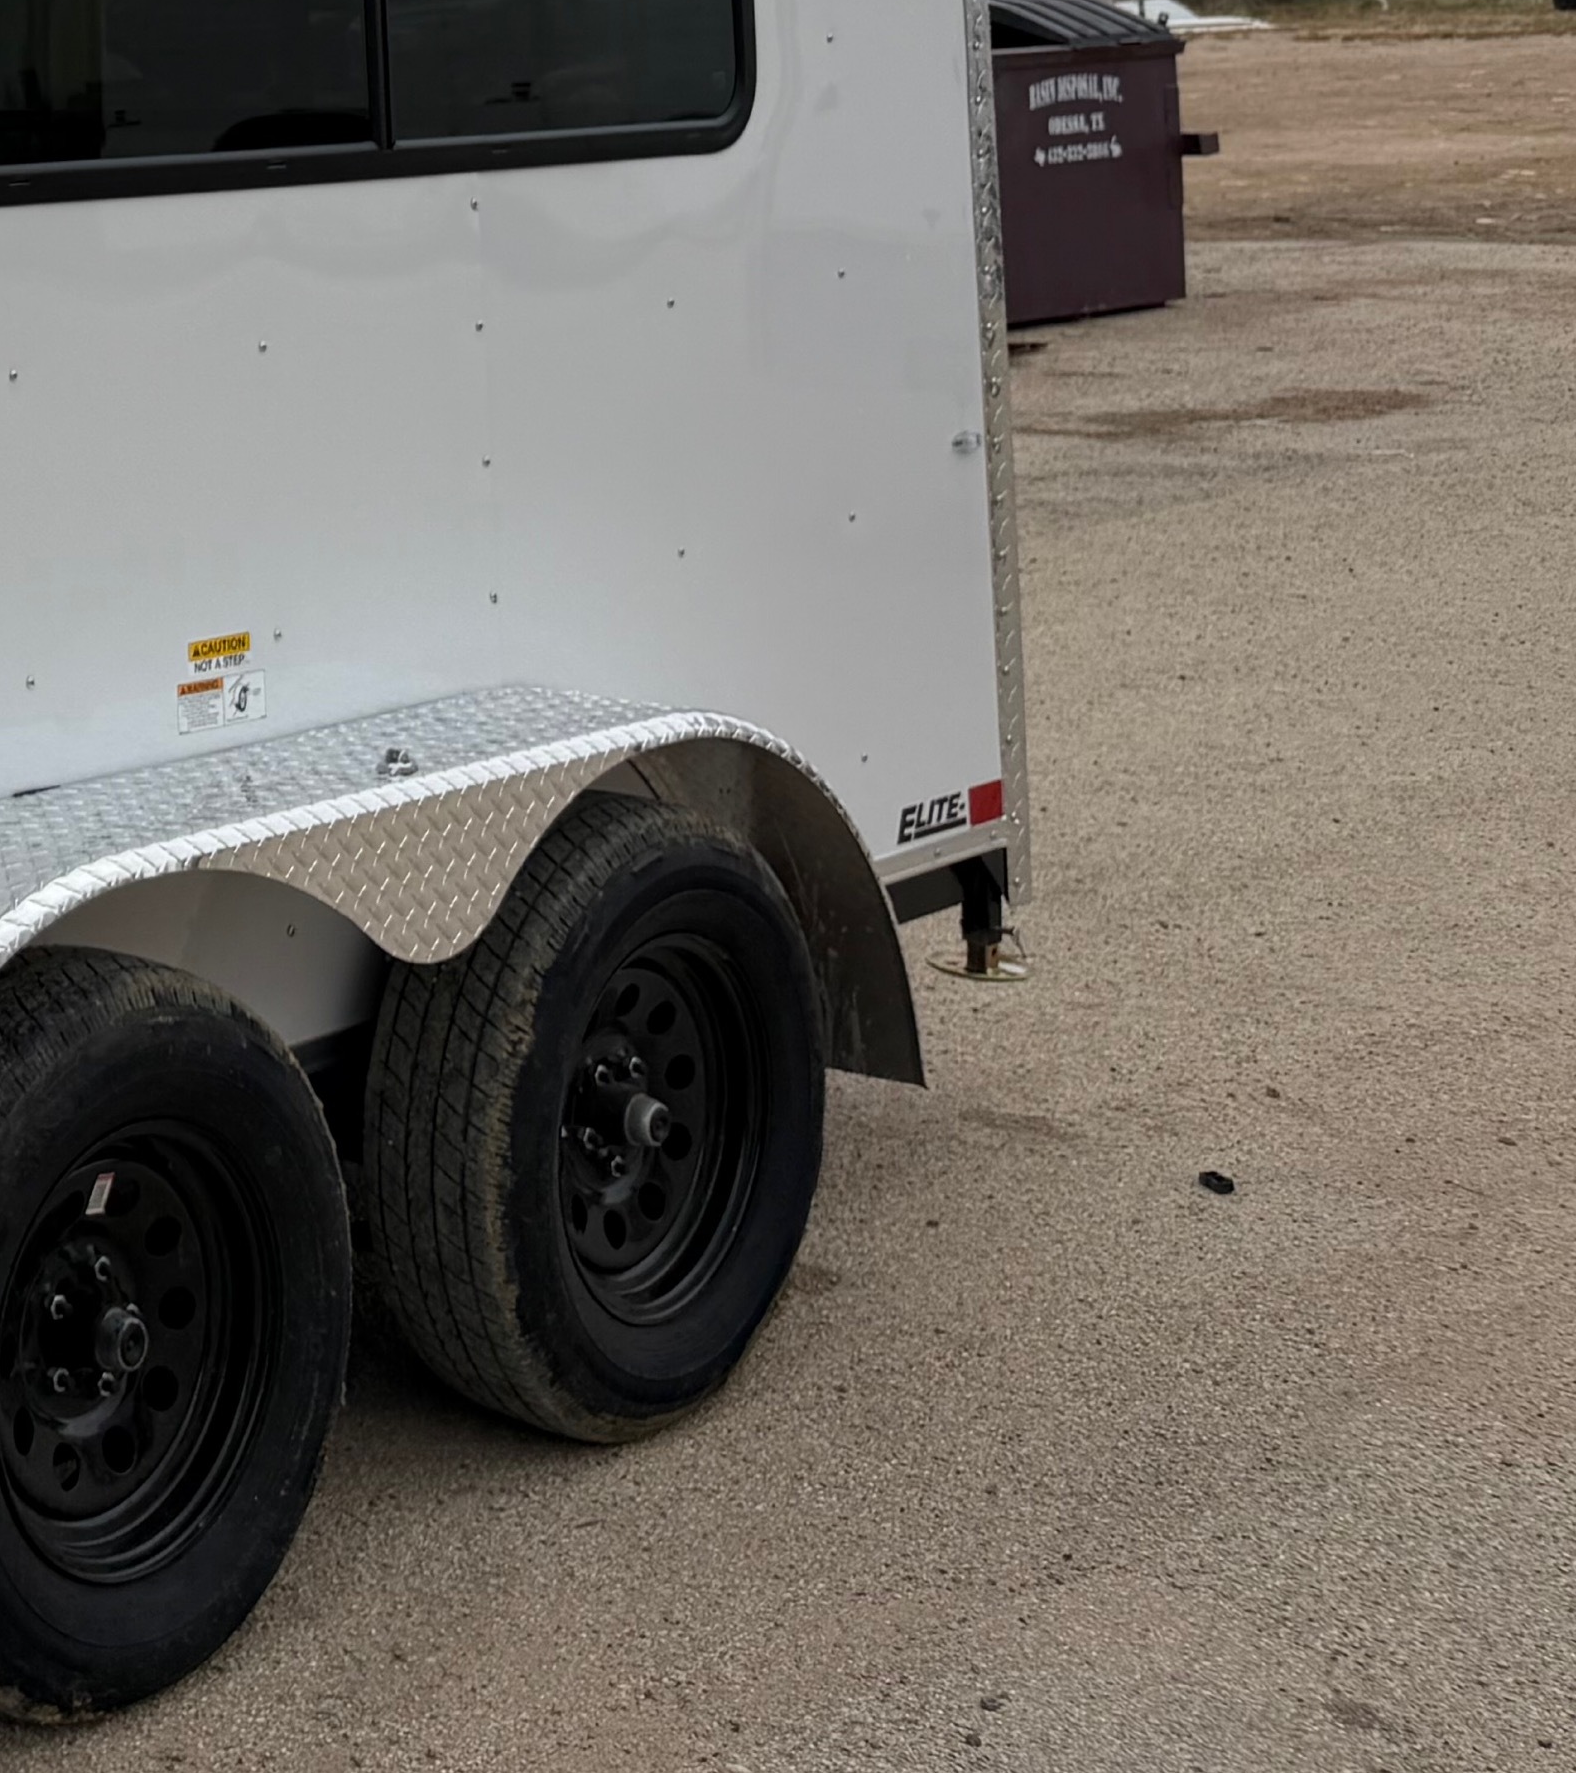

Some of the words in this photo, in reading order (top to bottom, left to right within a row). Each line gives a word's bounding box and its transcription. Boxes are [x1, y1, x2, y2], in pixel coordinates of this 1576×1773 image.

[201, 635, 247, 656] CAUTION
[194, 659, 213, 673] NOT
[214, 657, 222, 669] A
[223, 653, 245, 669] STEP
[897, 791, 961, 845] ELITE
